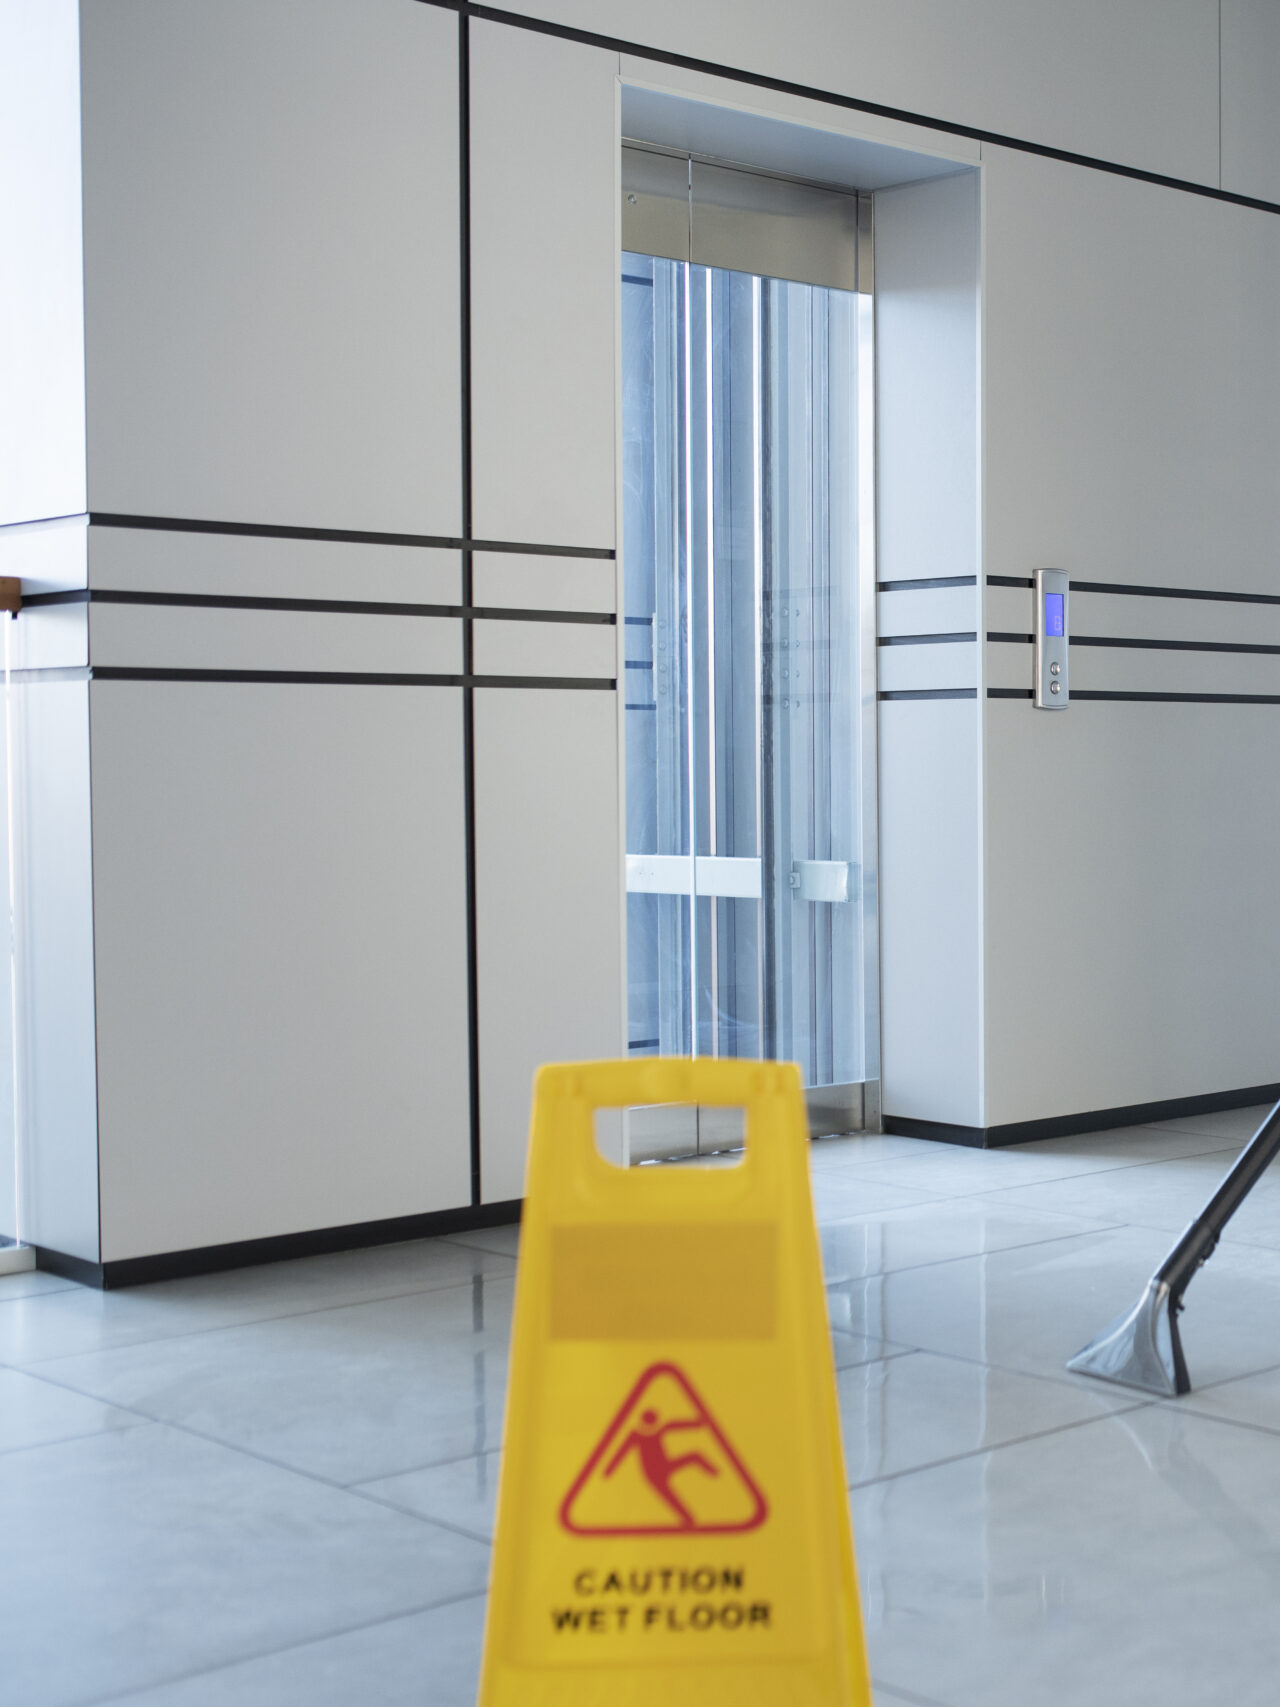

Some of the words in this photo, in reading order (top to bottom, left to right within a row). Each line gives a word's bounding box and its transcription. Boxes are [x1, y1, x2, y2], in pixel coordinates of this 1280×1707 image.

[573, 1565, 745, 1595] CAUTION
[551, 1604, 630, 1633] WET
[643, 1600, 772, 1631] FLOOR
